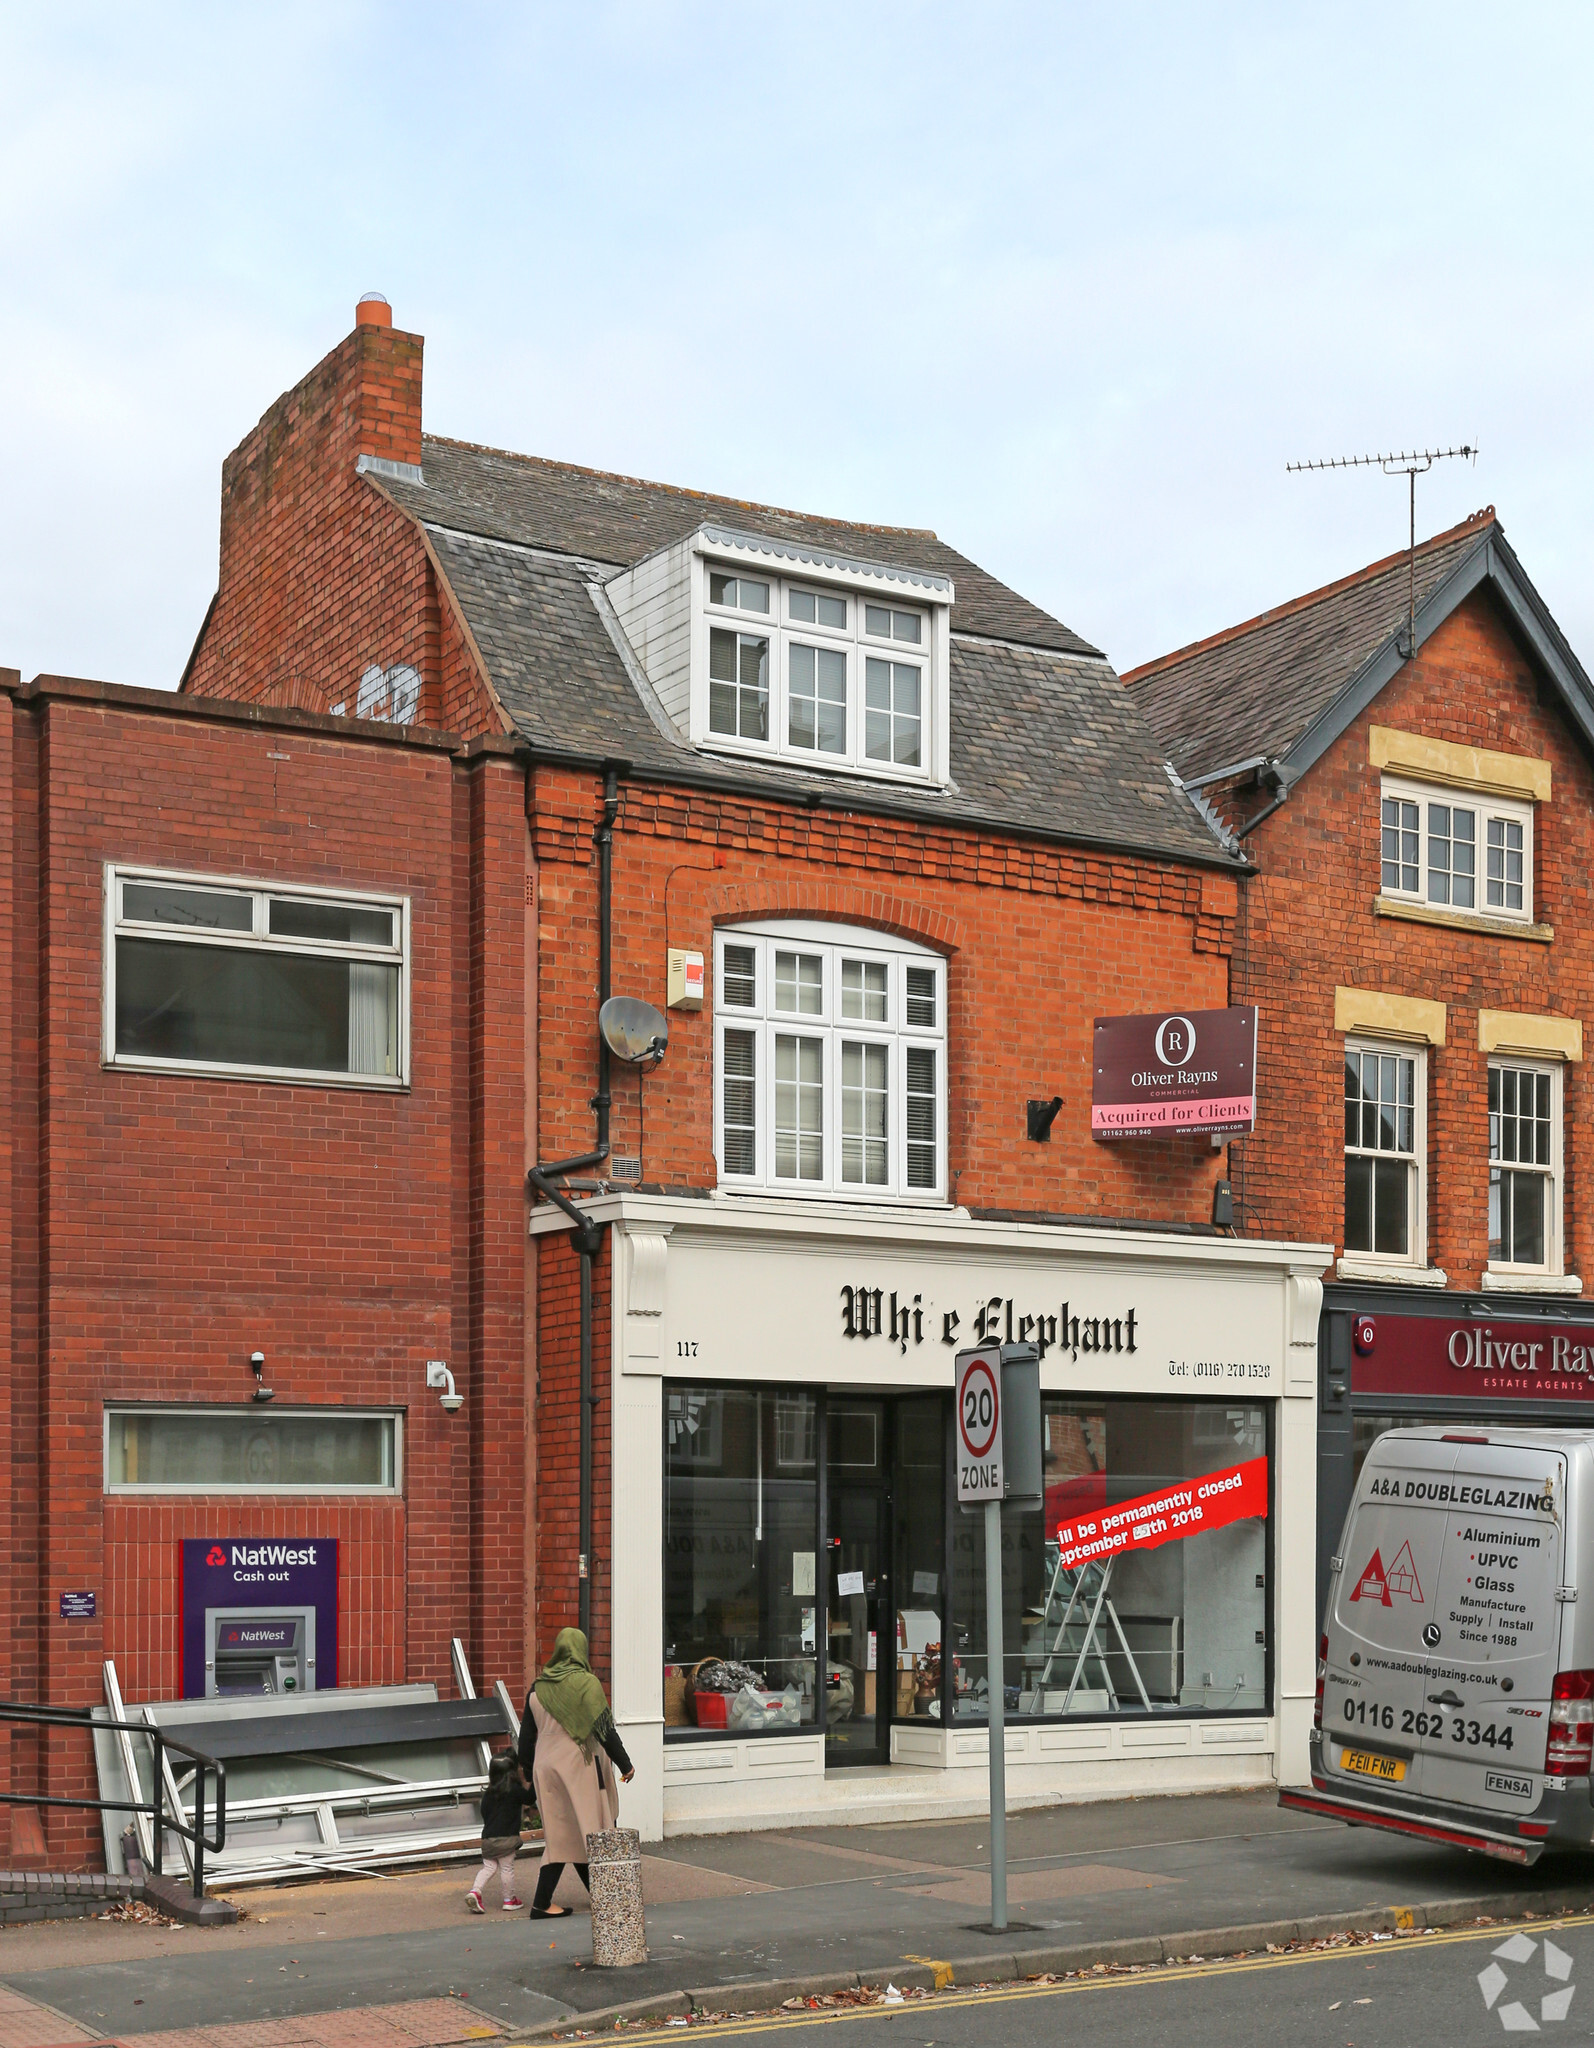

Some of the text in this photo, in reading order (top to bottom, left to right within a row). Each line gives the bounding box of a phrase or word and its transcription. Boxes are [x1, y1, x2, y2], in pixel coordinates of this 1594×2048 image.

[1131, 1070, 1218, 1087] Oliver Rayns
[1150, 1089, 1199, 1097] COMMERCIAL
[1096, 1103, 1250, 1125] Acquired for Clients
[1176, 1123, 1243, 1133] www.oliverrayns.com
[840, 1285, 1139, 1362] Whie Elephant
[677, 1341, 699, 1357] 117
[1448, 1328, 1543, 1371] Oliver
[1168, 1360, 1271, 1378] Tel: (0116) 270 1528
[1483, 1378, 1583, 1391] ESTATE AGENTS
[965, 1388, 992, 1428] 20
[962, 1464, 999, 1489] ZONE
[1370, 1477, 1554, 1512] A&A DOUBLEGLAZING
[1057, 1528, 1074, 1545] ill
[1077, 1522, 1097, 1538] be
[1101, 1490, 1193, 1533] permanently
[1197, 1472, 1243, 1500] closed
[1060, 1530, 1128, 1565] eptember
[1171, 1506, 1204, 1528] 2018
[1463, 1527, 1541, 1548] Aluminium
[231, 1545, 317, 1566] NatWest
[1477, 1552, 1519, 1569] UPVC
[233, 1570, 290, 1581] Cash out
[1474, 1575, 1515, 1593] Glass
[1460, 1596, 1526, 1613] Manufacture
[1449, 1611, 1533, 1631] Supply Install
[241, 1630, 285, 1641] NatWest
[1459, 1630, 1517, 1647] Since 1988
[1366, 1657, 1498, 1686] www.aadoubleglazing.co.uk
[1524, 1709, 1543, 1718] CDI
[1343, 1698, 1514, 1750] 0116 262 3344
[1371, 1757, 1396, 1777] FNR
[1488, 1775, 1530, 1794] FENSA
